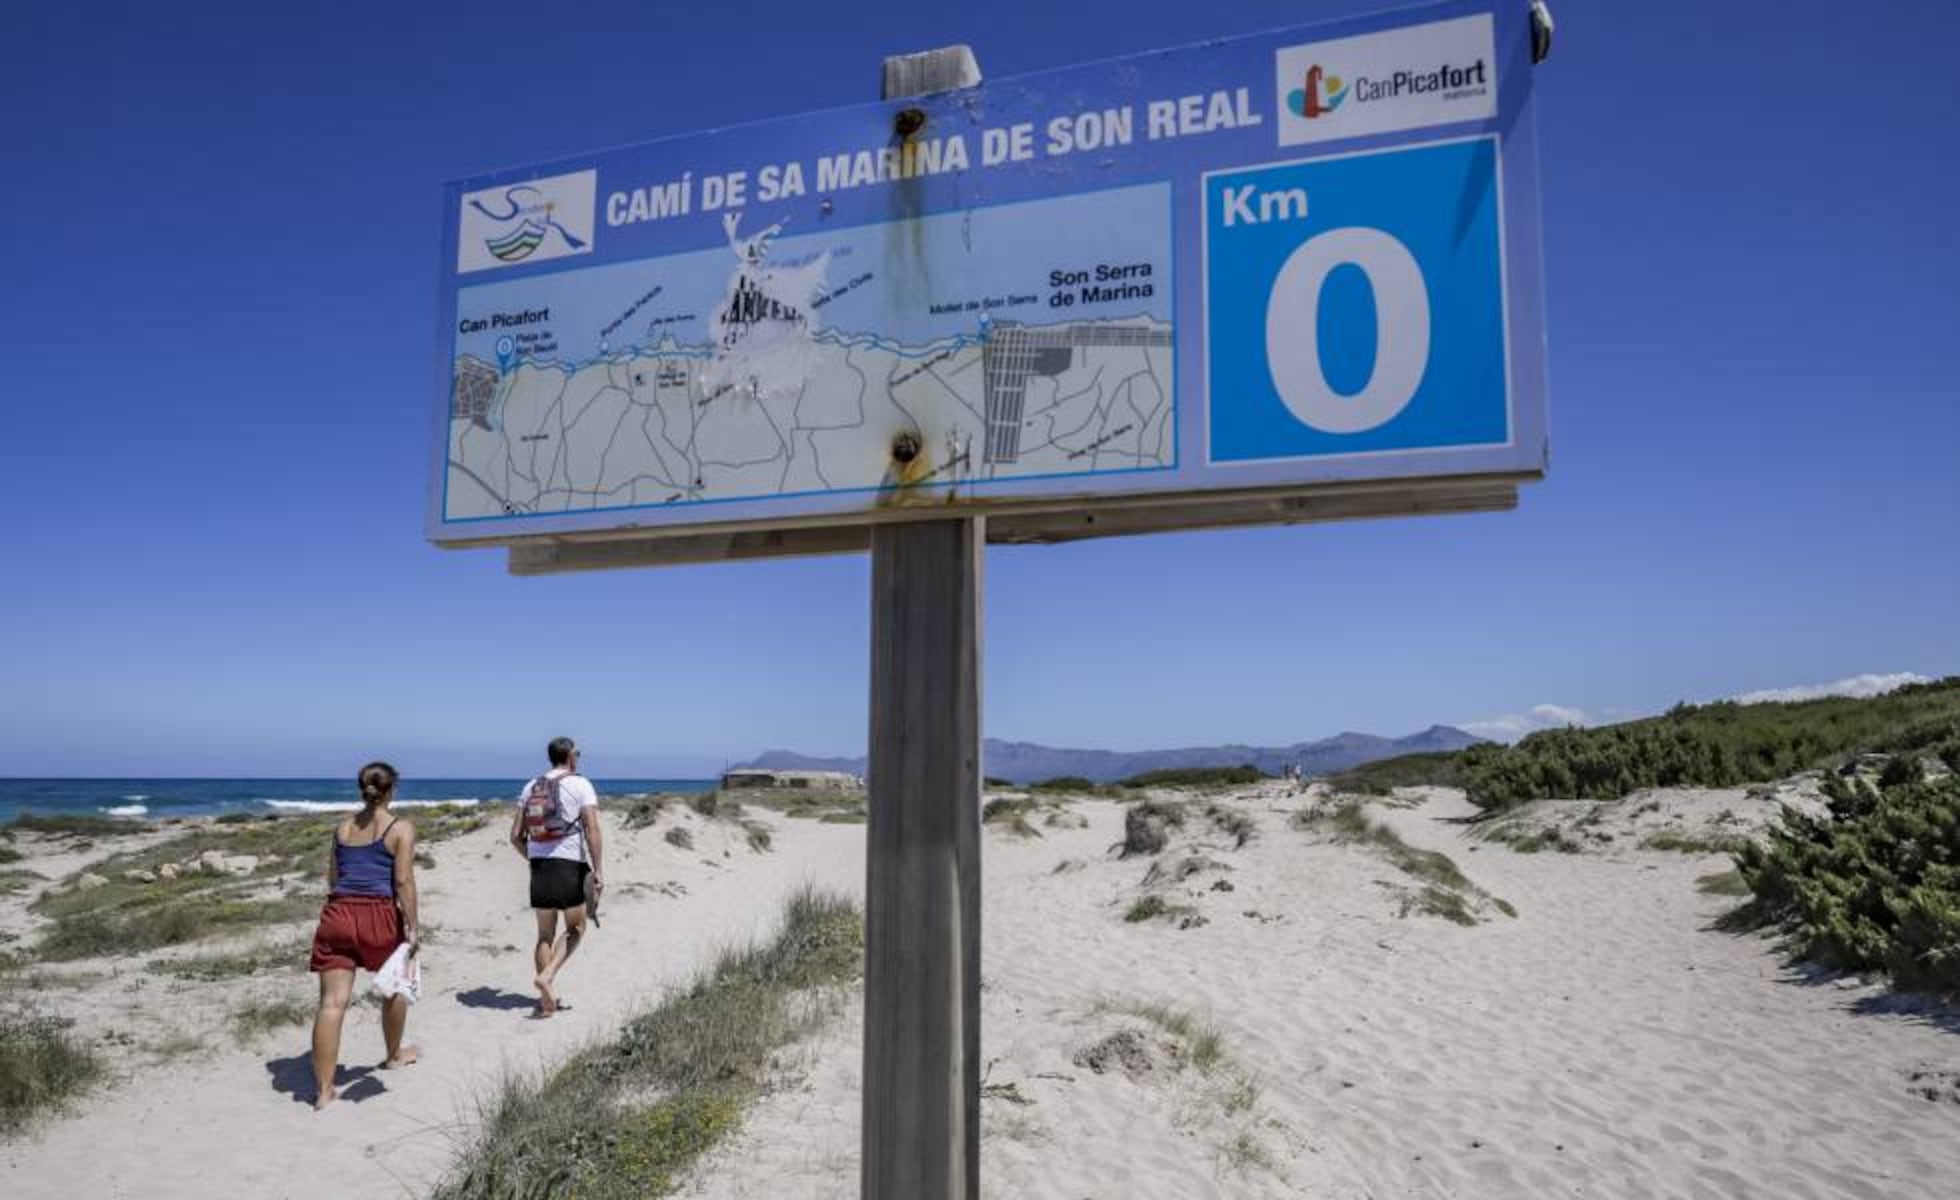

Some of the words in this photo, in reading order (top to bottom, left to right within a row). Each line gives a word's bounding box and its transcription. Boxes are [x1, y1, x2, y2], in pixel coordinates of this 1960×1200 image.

[607, 171, 691, 226] CAMÍ
[702, 171, 747, 211] DE
[758, 161, 805, 201] SA
[817, 135, 969, 193] MARINA
[982, 123, 1033, 167] DE
[1047, 106, 1132, 154] SON
[1148, 88, 1262, 140] REAL
[1222, 184, 1308, 227] Km
[1049, 270, 1089, 287] Son
[1095, 263, 1152, 282] Serra
[1049, 290, 1074, 307] de
[1082, 282, 1153, 304] Marina
[459, 319, 488, 334] Can
[491, 307, 549, 329] Picafort
[1266, 227, 1430, 433] 0
